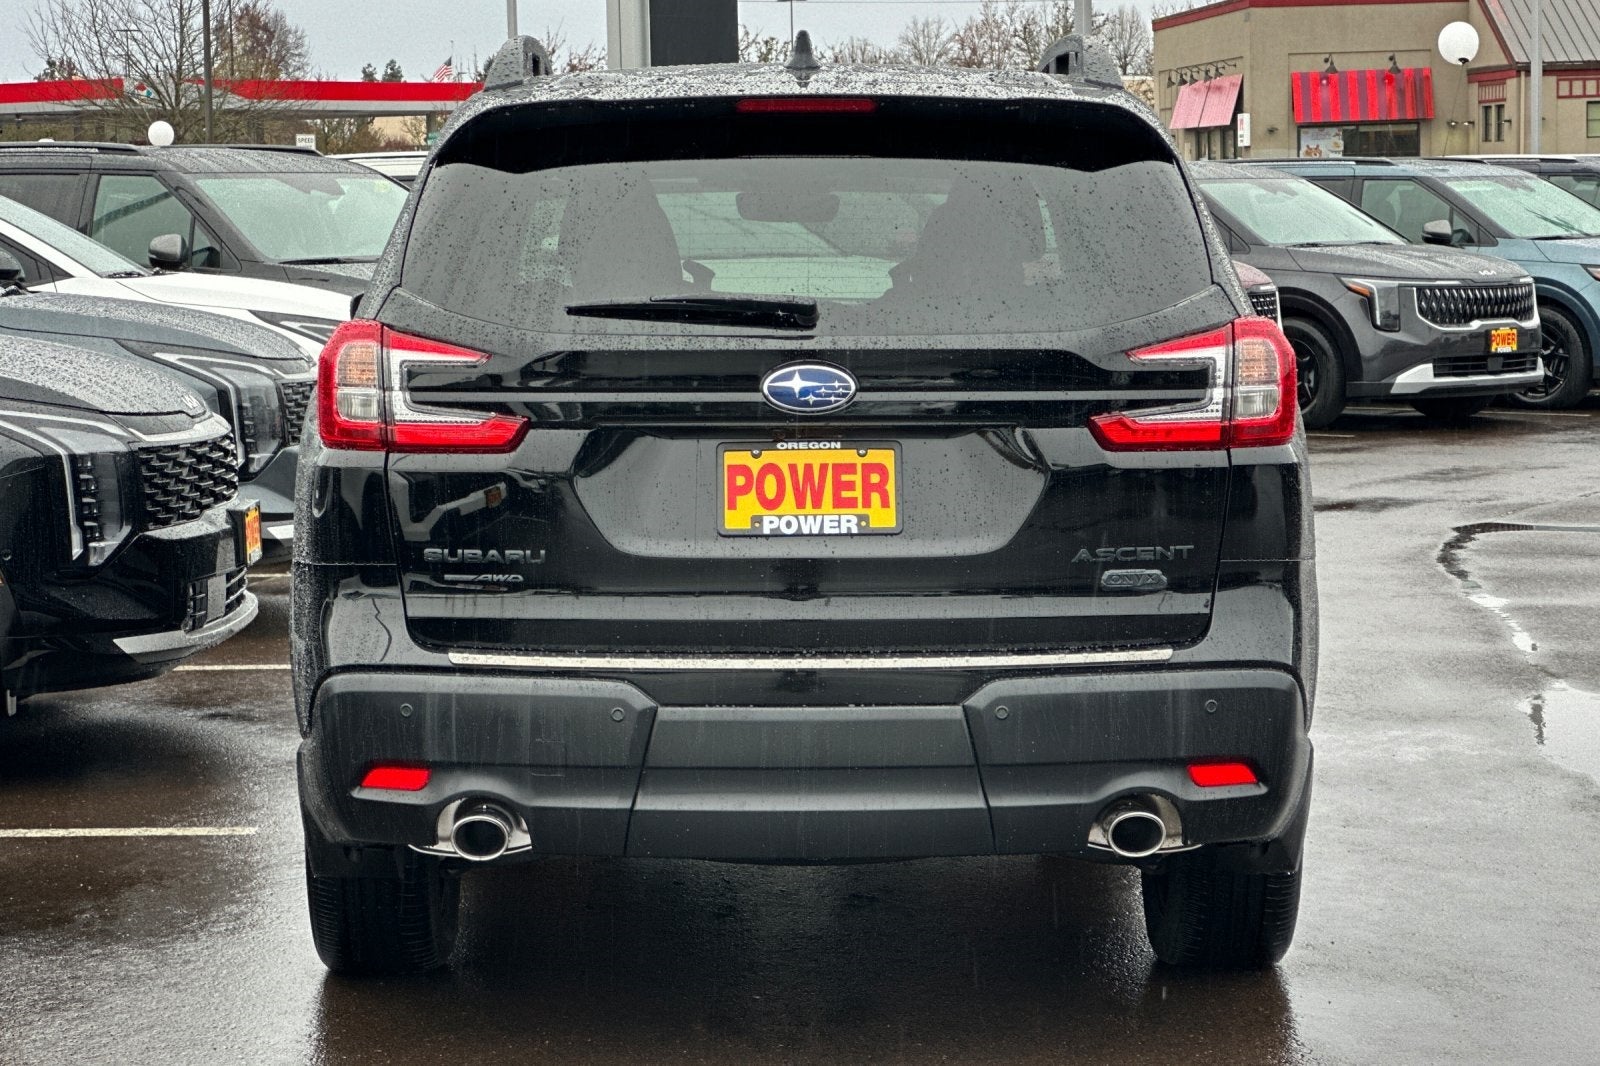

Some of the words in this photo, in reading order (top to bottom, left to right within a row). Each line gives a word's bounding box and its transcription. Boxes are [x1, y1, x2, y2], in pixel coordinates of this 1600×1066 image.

[1490, 332, 1516, 346] POWER
[776, 441, 841, 450] OREGON
[726, 462, 891, 511] POWER
[762, 515, 858, 535] POWER
[423, 548, 546, 564] SUBARU
[1071, 545, 1195, 563] ASCENT
[474, 574, 525, 582] AWD
[1108, 574, 1158, 586] ONYX
